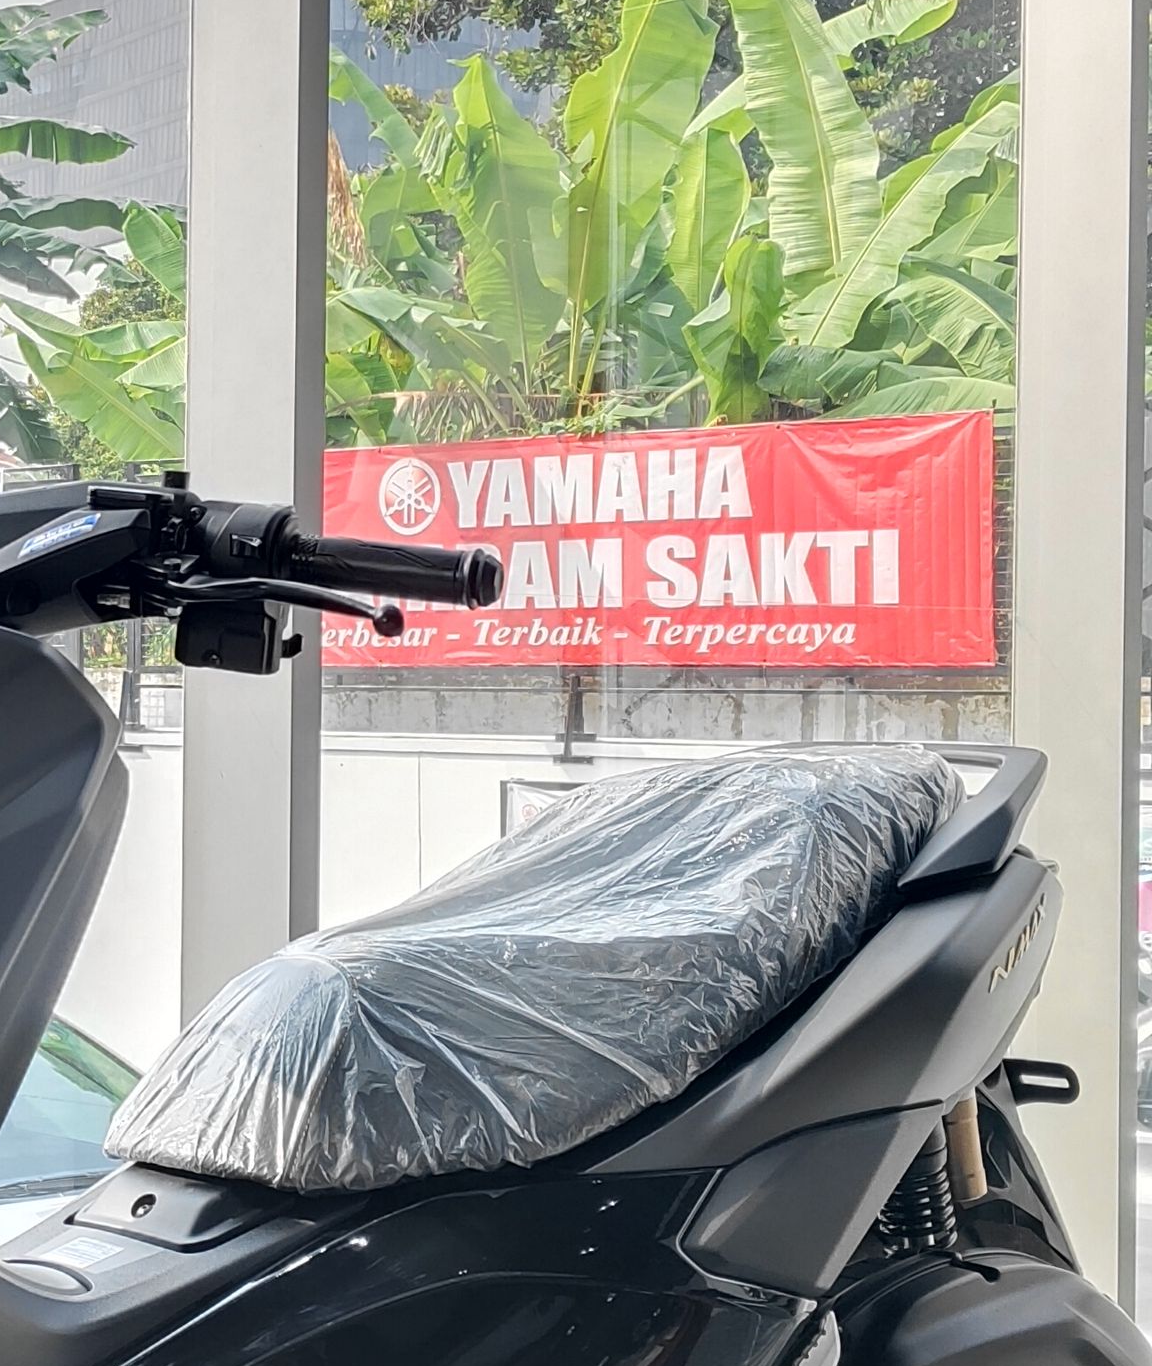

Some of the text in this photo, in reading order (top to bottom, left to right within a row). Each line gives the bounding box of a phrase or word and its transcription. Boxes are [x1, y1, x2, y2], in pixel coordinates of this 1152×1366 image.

[448, 446, 753, 528] YAMAHA
[645, 529, 900, 609] SAKTI
[322, 618, 438, 648] erbesar
[473, 618, 602, 647] Terbaik
[643, 616, 857, 653] Terpercaya
